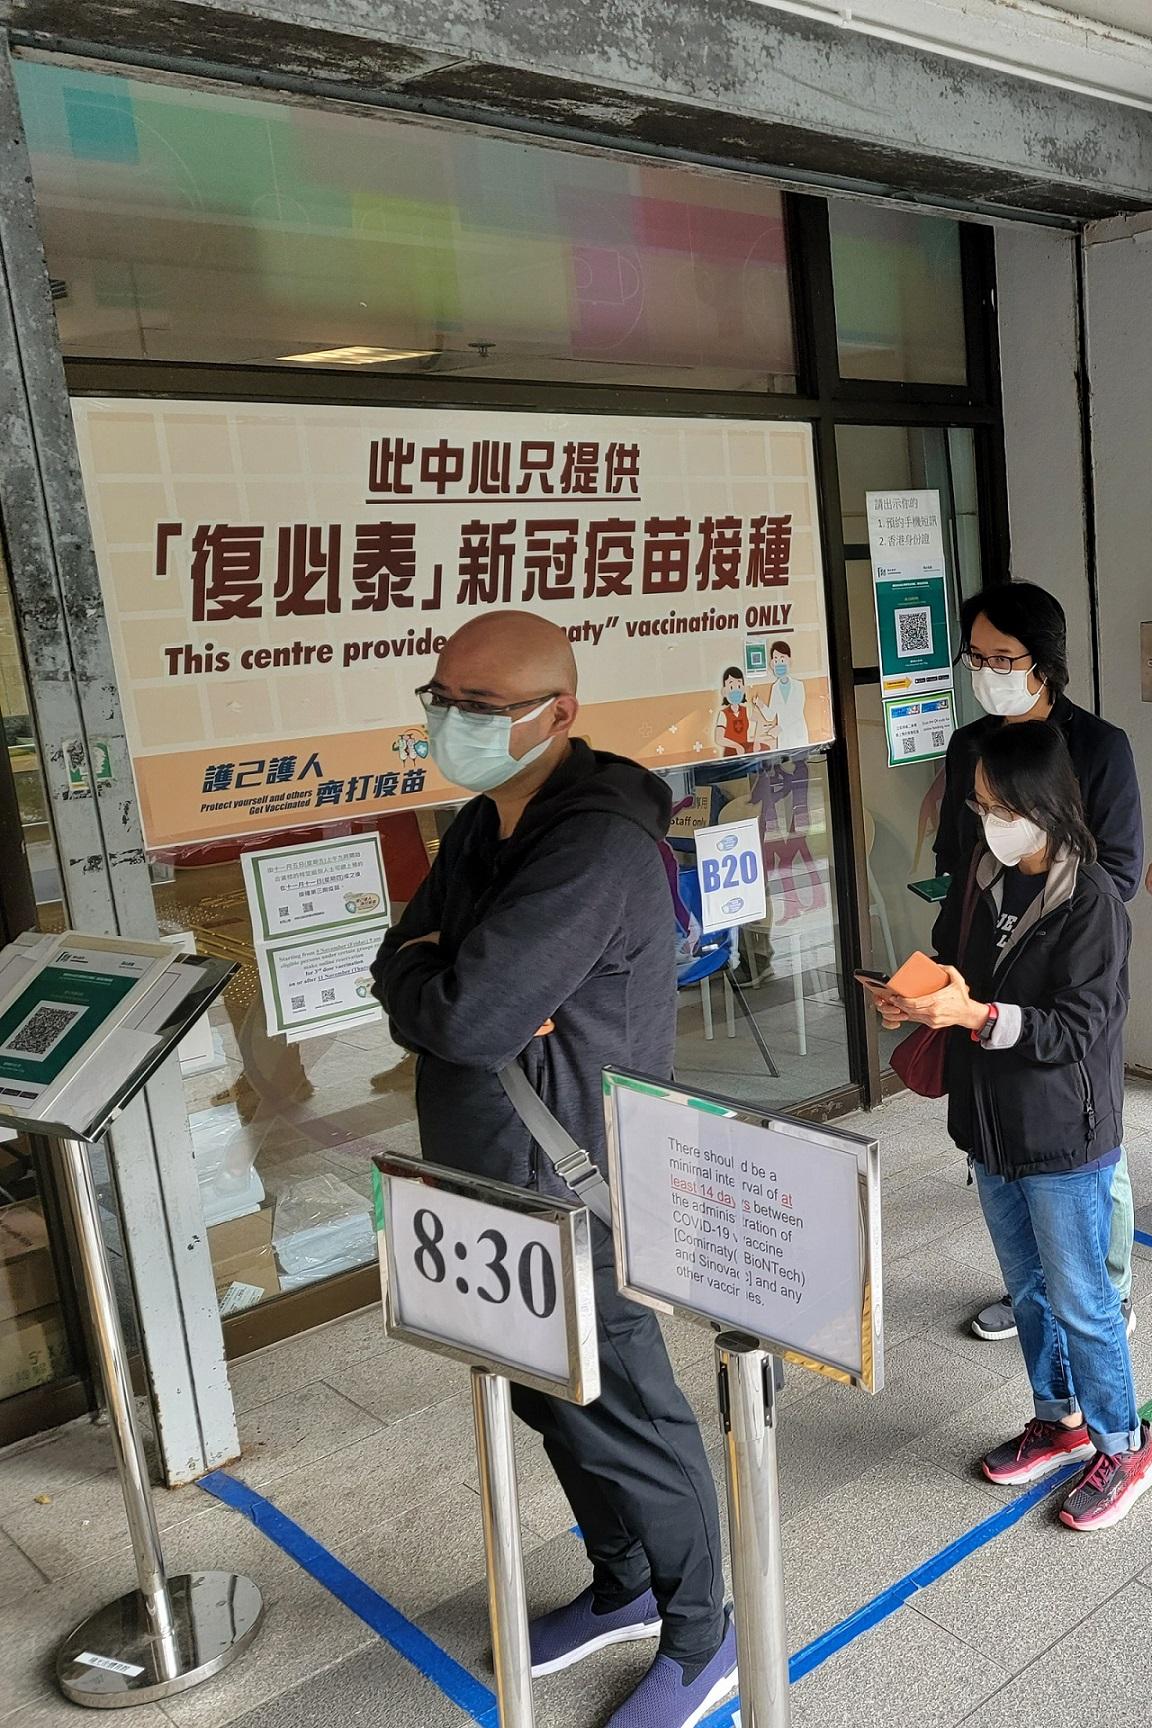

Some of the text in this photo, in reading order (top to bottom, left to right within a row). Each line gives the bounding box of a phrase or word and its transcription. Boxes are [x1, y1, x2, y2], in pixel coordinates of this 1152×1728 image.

[369, 438, 641, 495] 此中心只提供
[155, 514, 792, 622] 「復必泰」新冠疫苗接種
[165, 643, 230, 675] This
[241, 641, 333, 670] centre
[343, 627, 448, 667] provide
[626, 607, 739, 637] vaccination
[745, 604, 792, 628] ONLY
[202, 752, 324, 793] 護己護人
[315, 768, 427, 808] 齊打疫苗
[200, 789, 313, 813] Protect yourself and others
[249, 798, 311, 815] Get Vaccinated
[702, 850, 758, 894] B20
[668, 1137, 700, 1158] There
[752, 1162, 766, 1178] be
[769, 1171, 777, 1181] a
[670, 1158, 712, 1180] minimal
[766, 1188, 778, 1200] of
[781, 1193, 793, 1206] at
[670, 1174, 697, 1194] least
[700, 1184, 714, 1198] 14
[754, 1201, 804, 1229] between
[672, 1192, 690, 1208] the
[780, 1230, 792, 1242] of
[673, 1210, 730, 1240] COVID-19
[412, 1208, 558, 1319] 8:30
[676, 1265, 704, 1283] other
[676, 1248, 696, 1264] and
[756, 1277, 777, 1292] and
[780, 1286, 802, 1304] any
